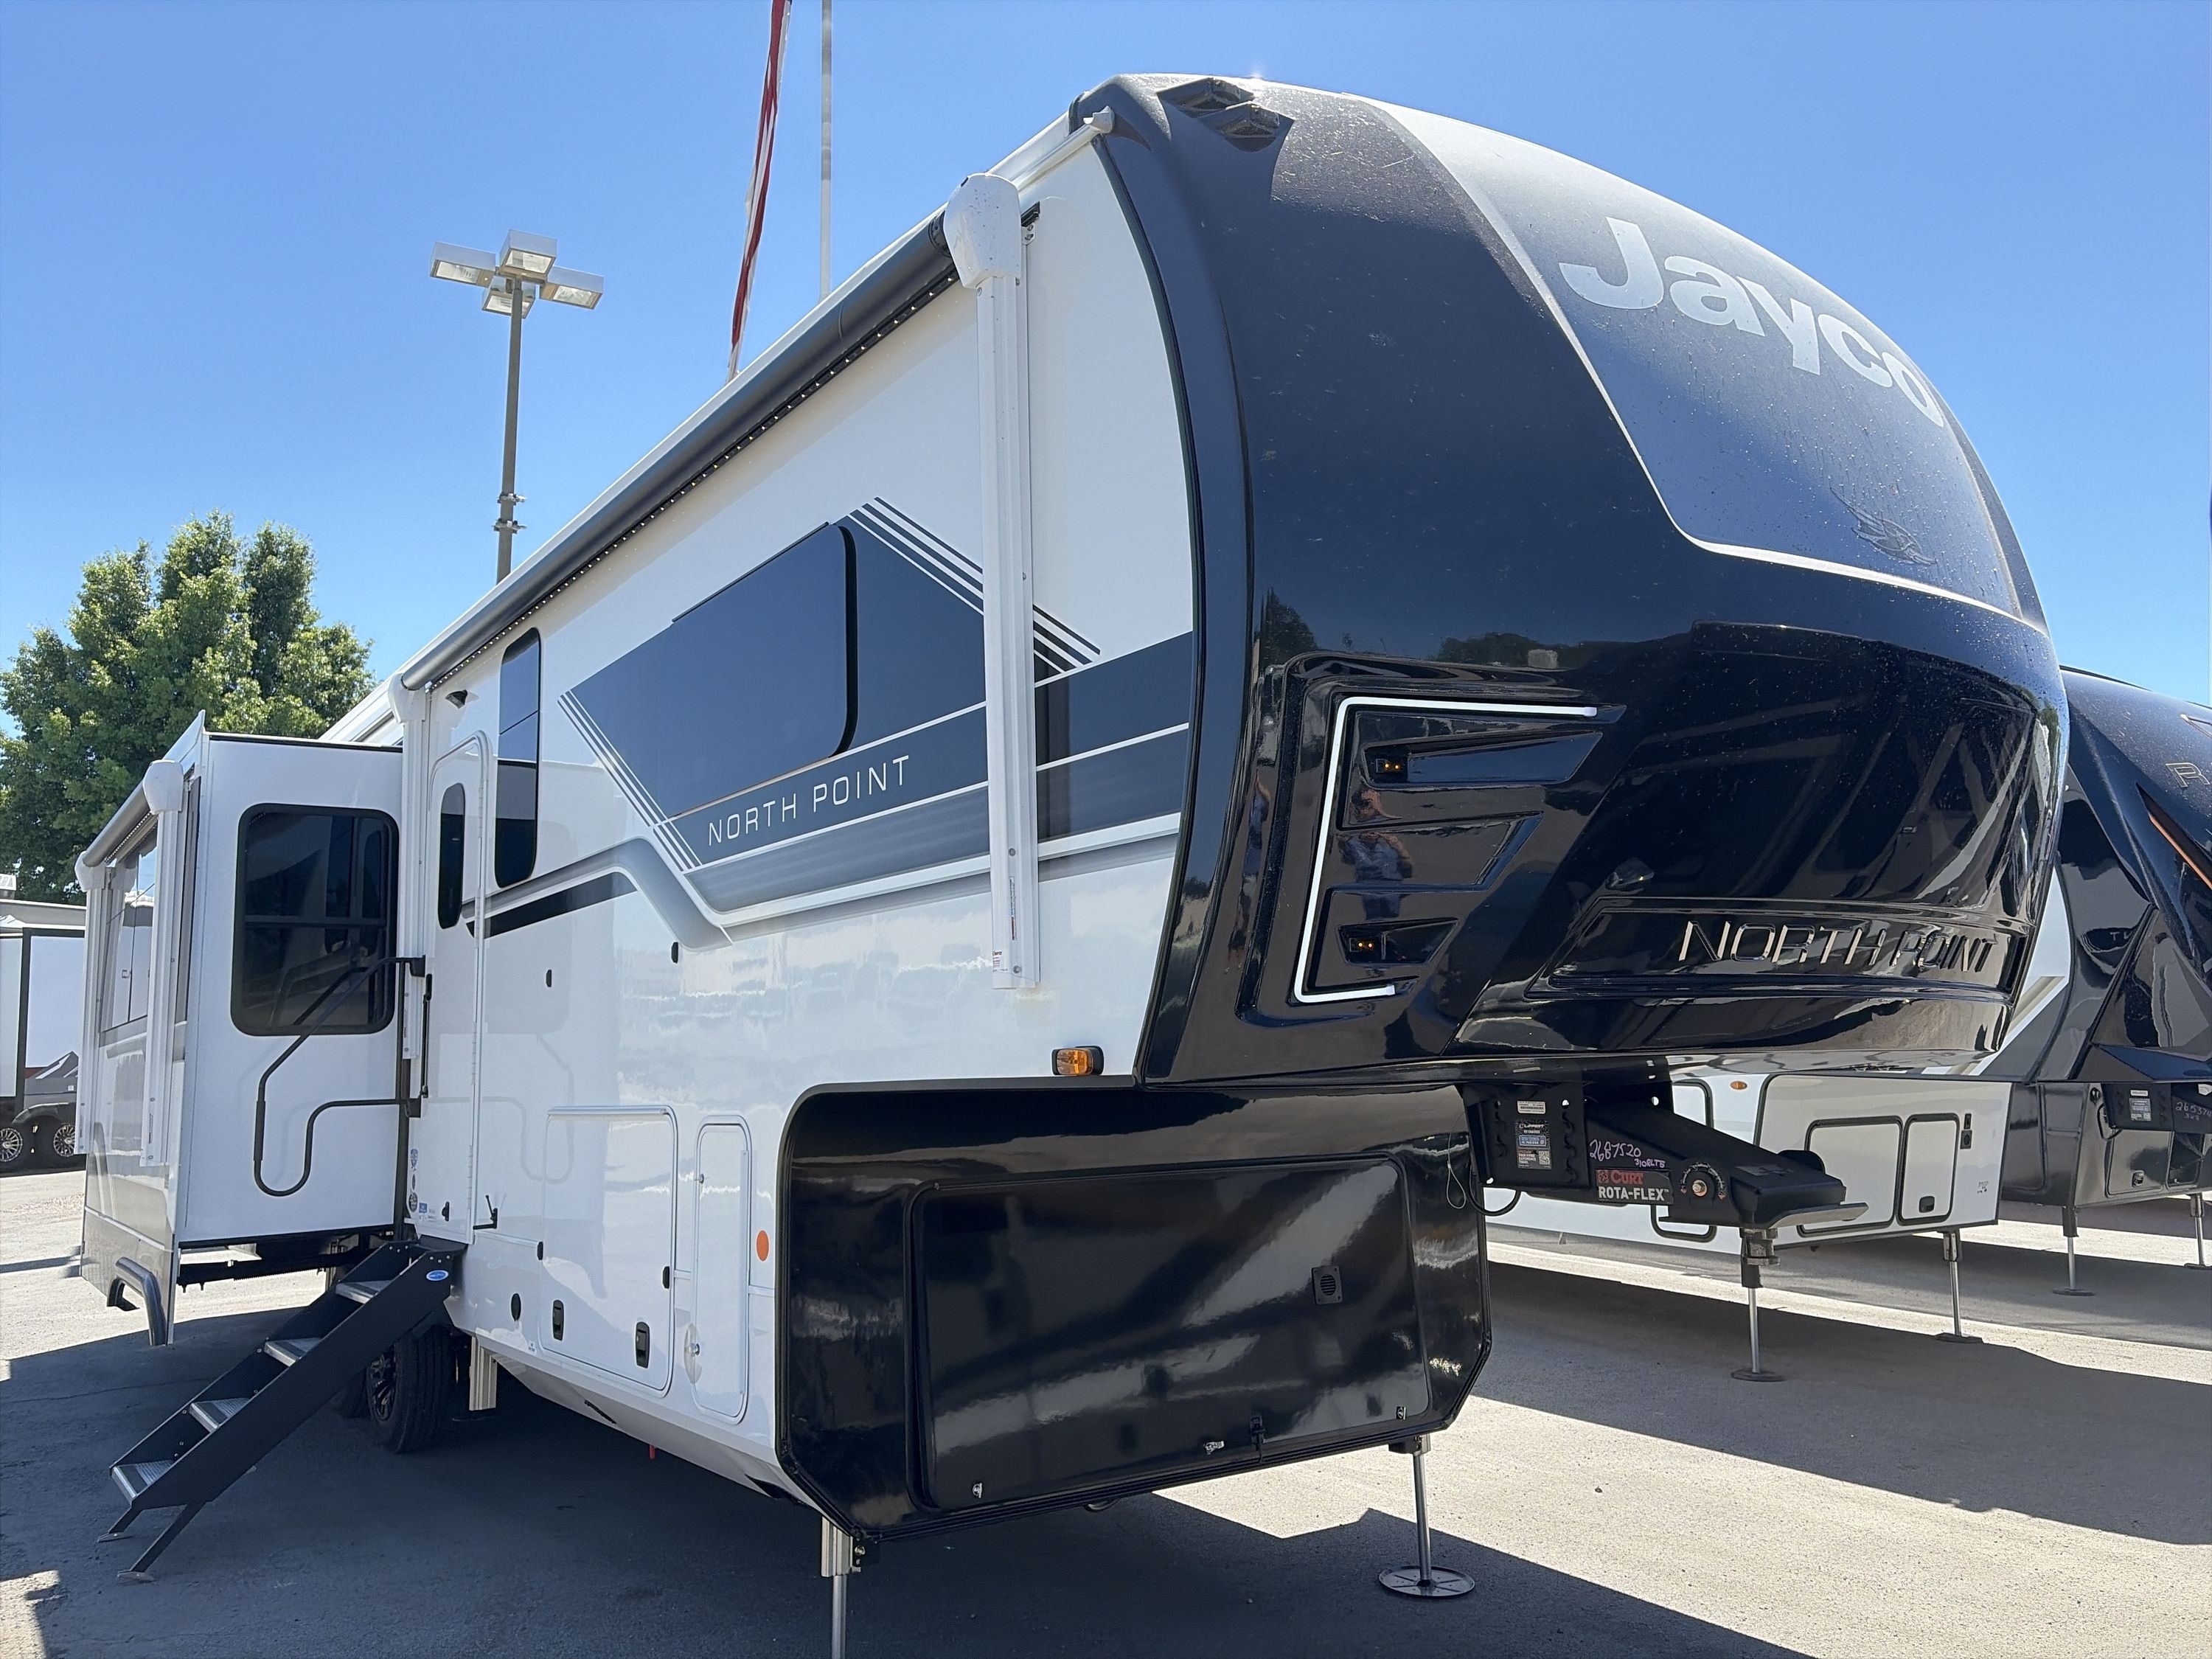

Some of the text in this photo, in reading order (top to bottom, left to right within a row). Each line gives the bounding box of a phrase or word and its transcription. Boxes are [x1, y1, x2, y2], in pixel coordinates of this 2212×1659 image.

[1558, 216, 1944, 427] Jayco
[709, 755, 909, 846] NORTH POINT
[1678, 920, 1998, 973] NORTH POINT
[1590, 1138, 1641, 1162] 2687520
